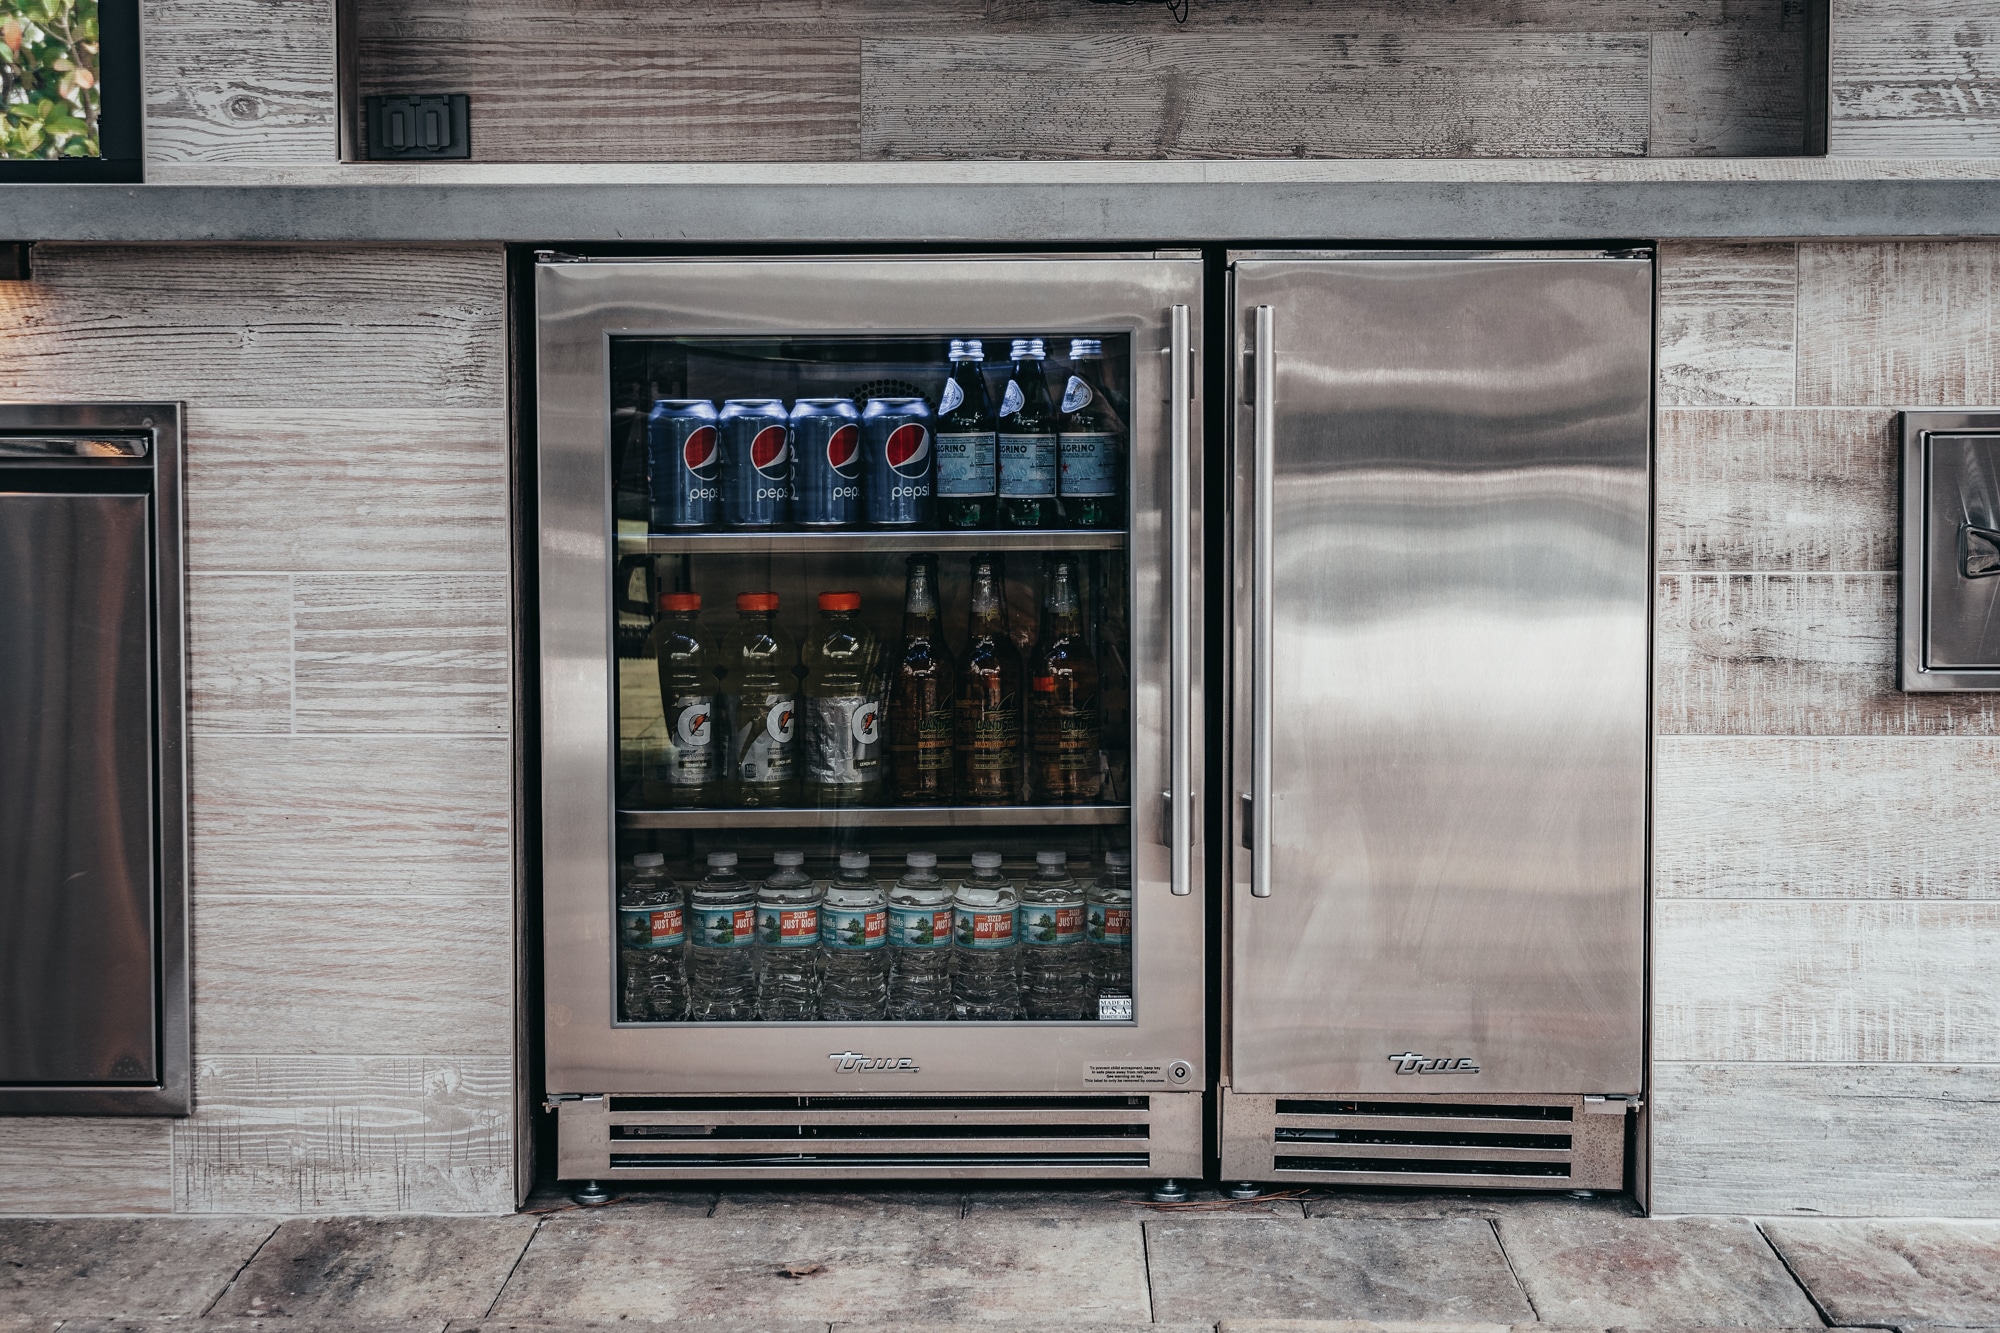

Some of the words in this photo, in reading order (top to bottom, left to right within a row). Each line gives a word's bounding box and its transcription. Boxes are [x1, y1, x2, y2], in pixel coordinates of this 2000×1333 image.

[756, 487, 789, 502] peps
[832, 486, 860, 501] pep
[891, 482, 930, 501] pepsi
[677, 702, 711, 746] G
[766, 699, 795, 743] G
[852, 701, 879, 745] G
[663, 910, 677, 919] SIZED
[793, 911, 808, 919] SIZED
[987, 914, 1002, 923] SIZED
[1118, 910, 1130, 918] SIZE
[653, 919, 669, 930] JUST
[735, 918, 750, 929] JUST
[782, 919, 799, 929] JUST
[801, 916, 817, 928] RIGHT
[866, 920, 880, 931] JUST
[935, 919, 948, 930] JUST
[976, 922, 992, 932] JUST
[994, 920, 1011, 932] RIGHT
[1058, 917, 1074, 927] JUST
[1106, 917, 1123, 927] JUST
[1101, 1005, 1131, 1015] U.S.A.
